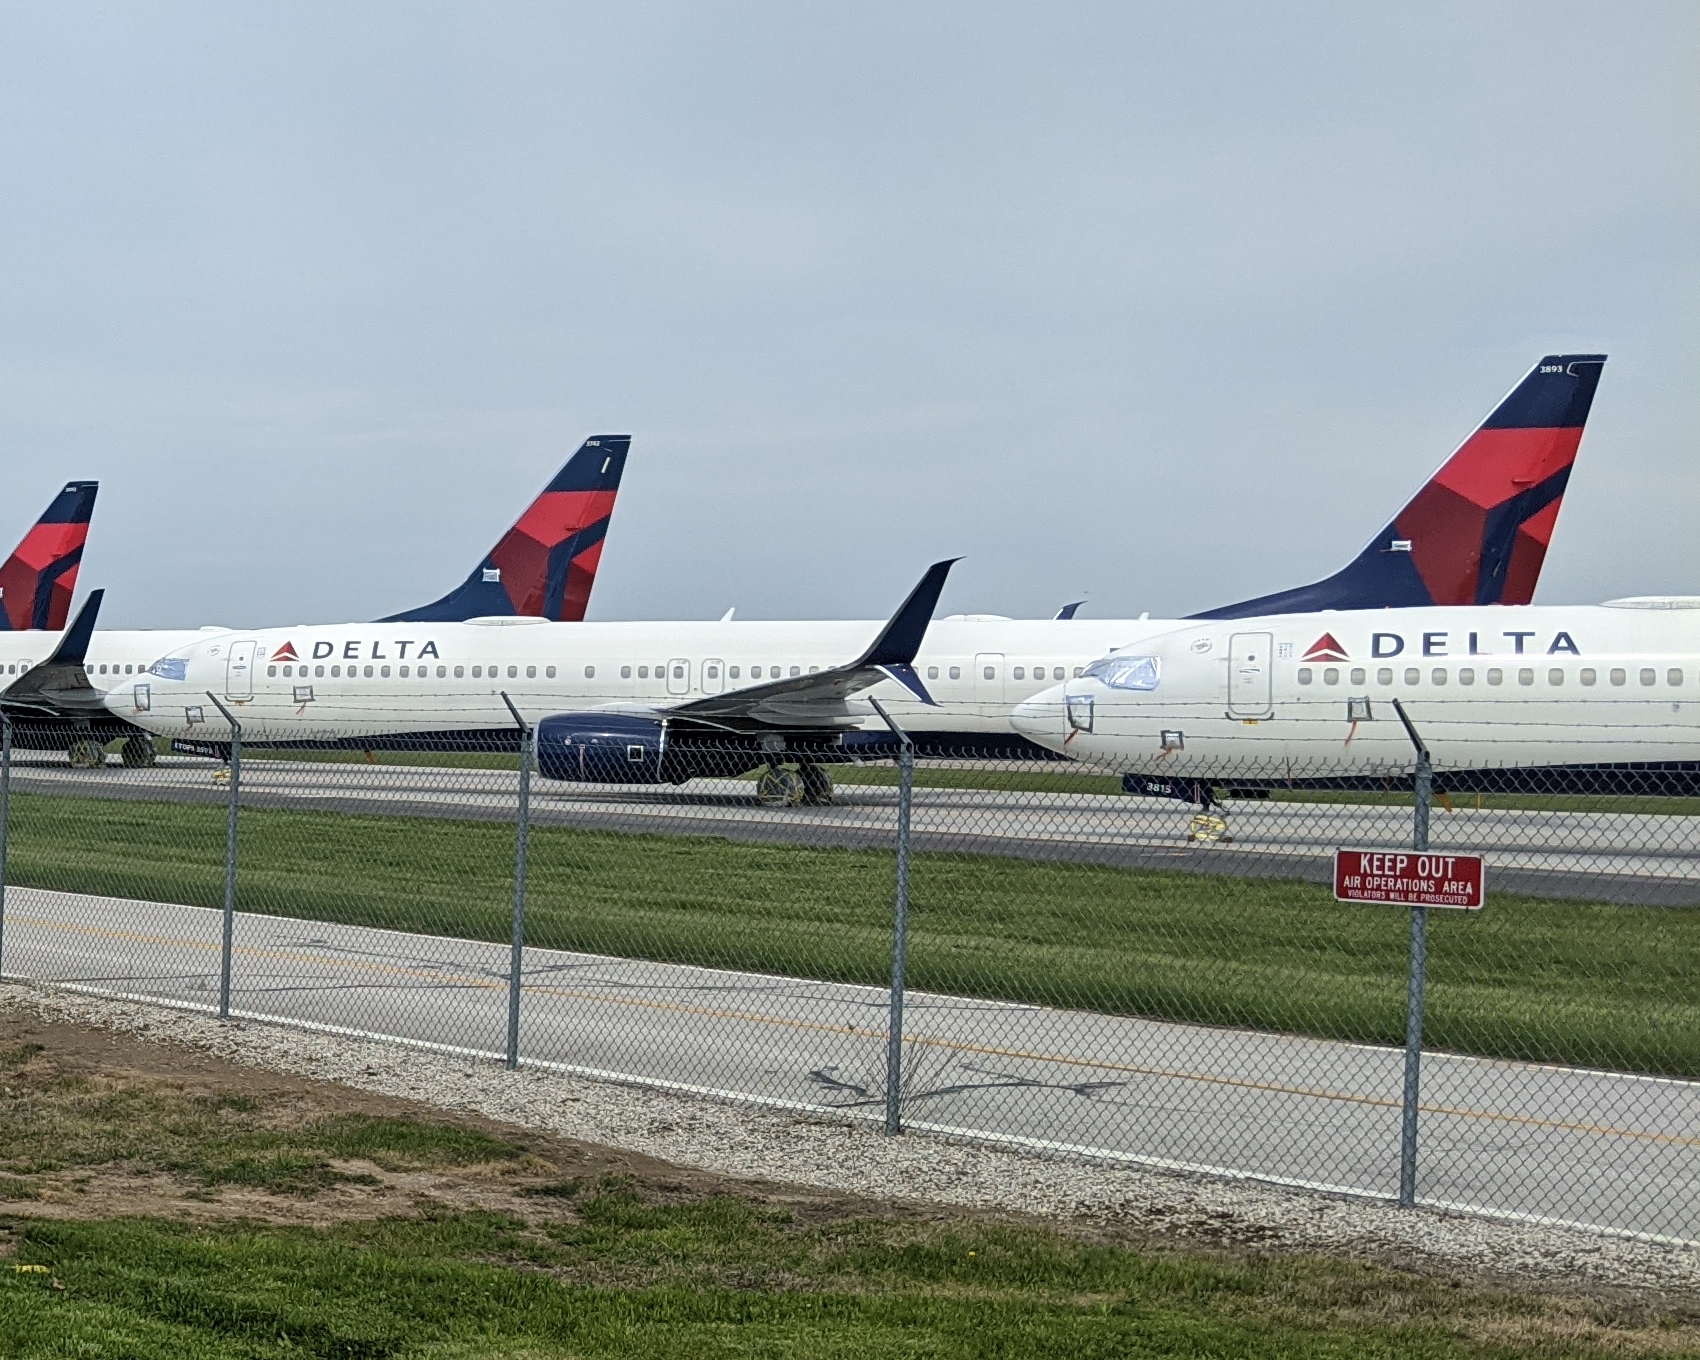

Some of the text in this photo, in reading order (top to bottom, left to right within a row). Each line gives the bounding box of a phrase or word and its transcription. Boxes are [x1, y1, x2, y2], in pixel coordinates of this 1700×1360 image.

[312, 641, 440, 659] DELTA
[1372, 631, 1581, 658] DELTA
[1146, 782, 1172, 794] 3815
[1360, 853, 1456, 878] KEEP OUT
[1343, 875, 1473, 895] AIR OPERATIONS AREA
[1347, 889, 1468, 905] VIOLATORS WILL BE PROSECUTED
